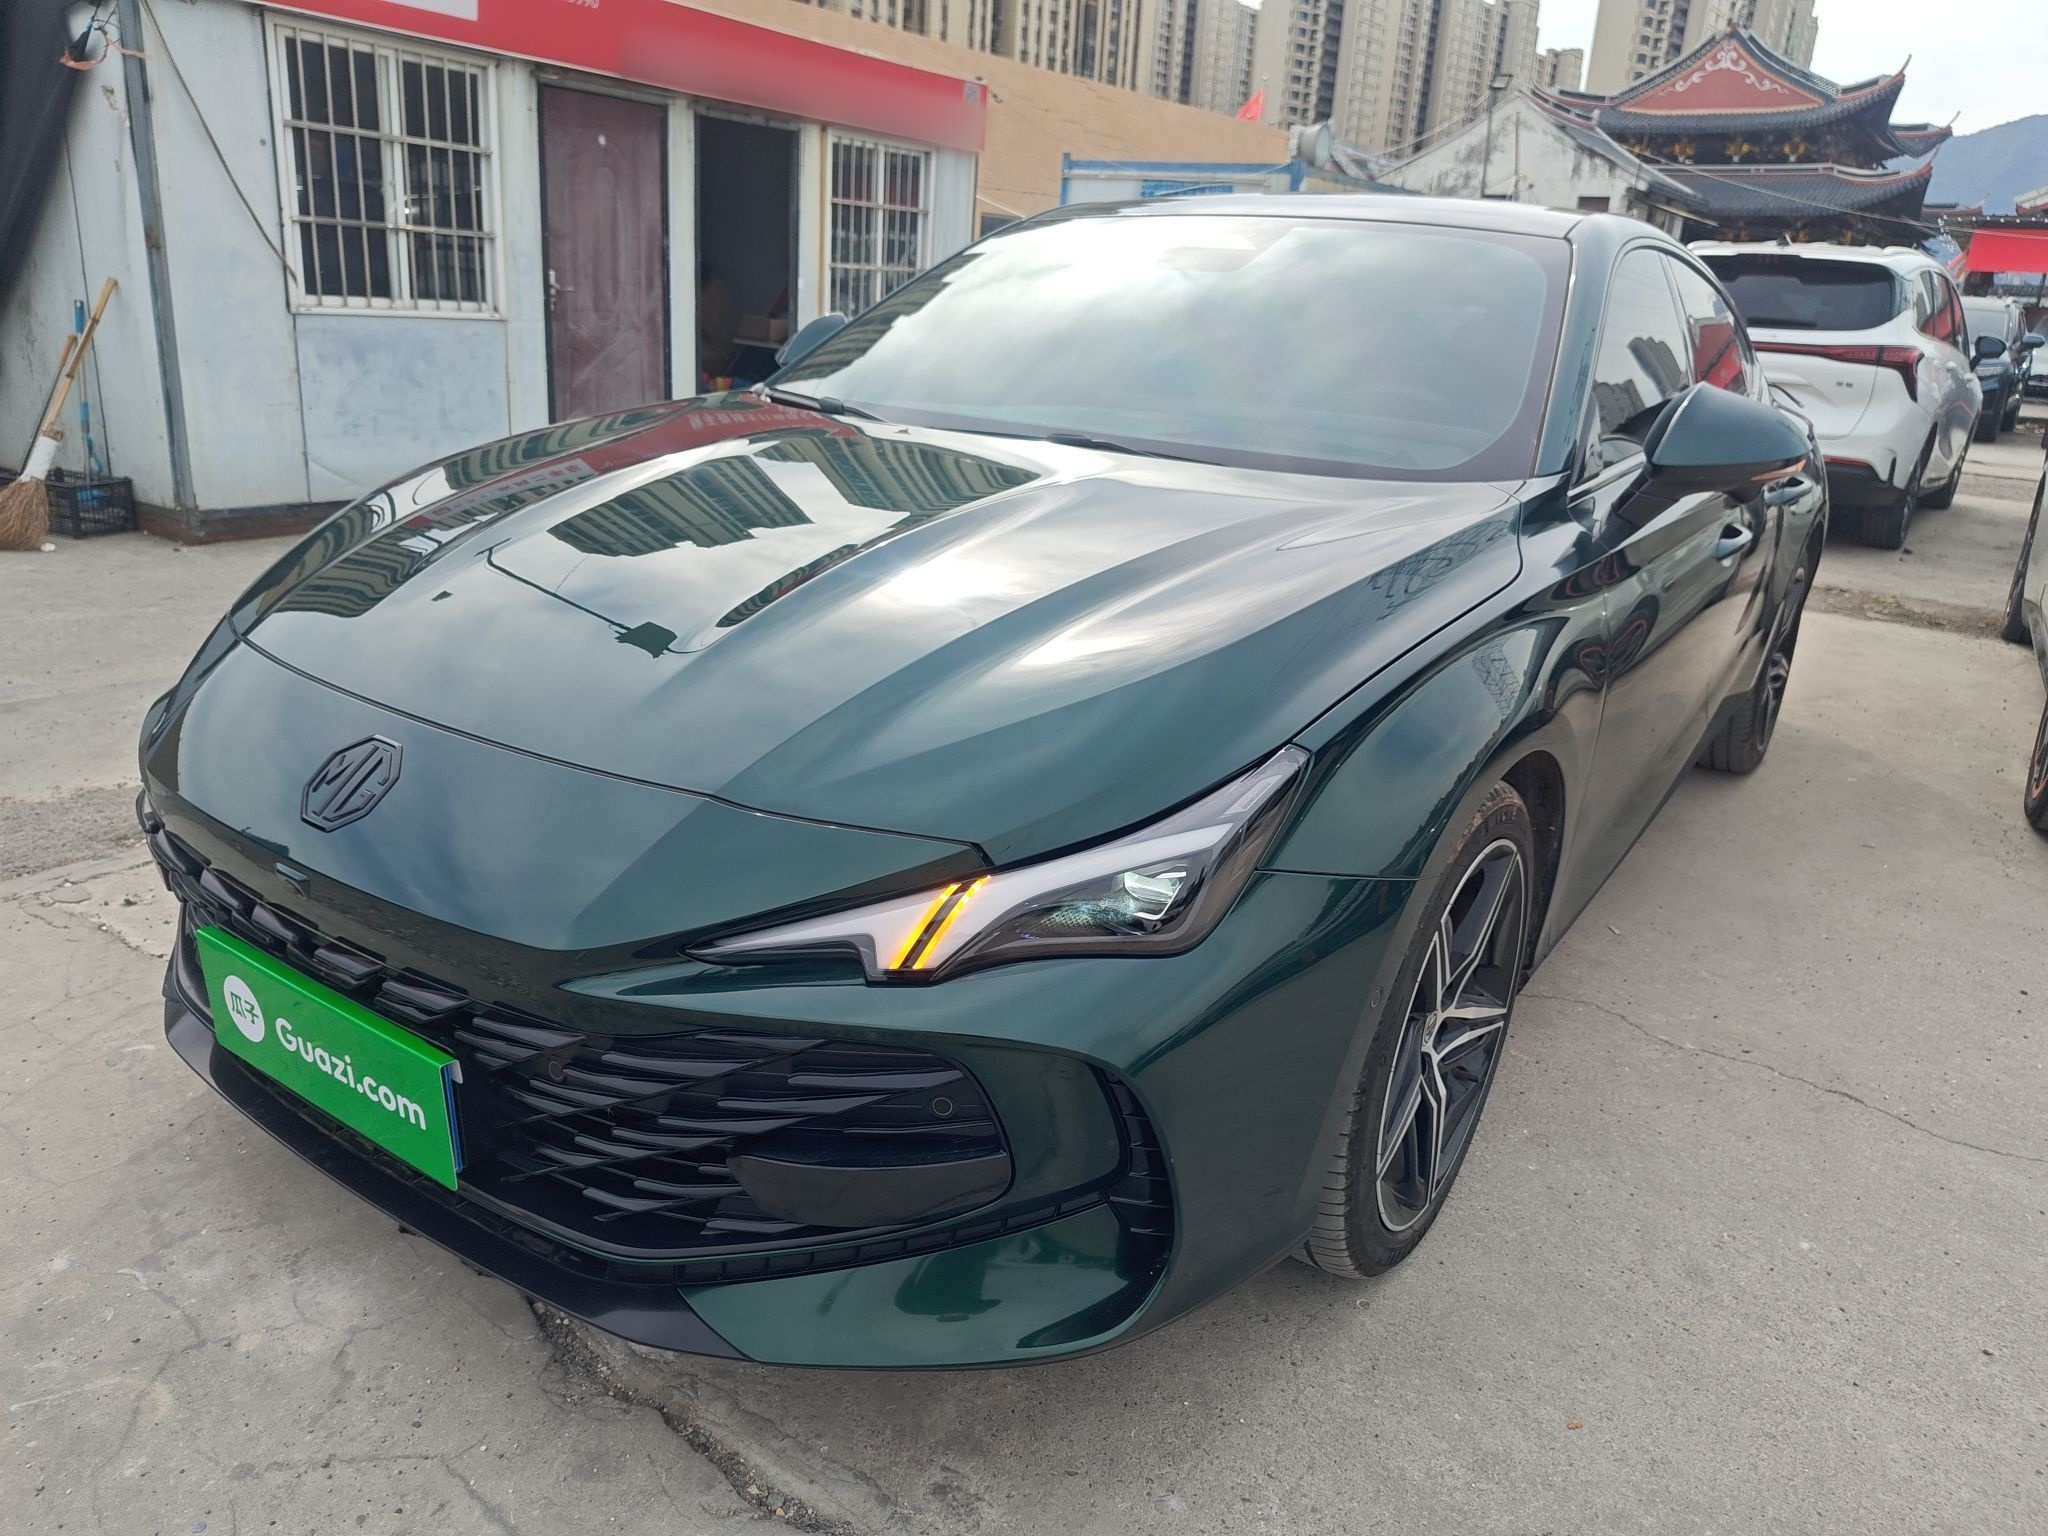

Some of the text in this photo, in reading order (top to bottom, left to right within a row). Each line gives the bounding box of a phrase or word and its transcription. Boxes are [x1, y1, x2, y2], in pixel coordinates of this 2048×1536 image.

[309, 743, 393, 823] MG
[229, 991, 259, 1025] 瓜子
[275, 1017, 427, 1131] Guazi.com
